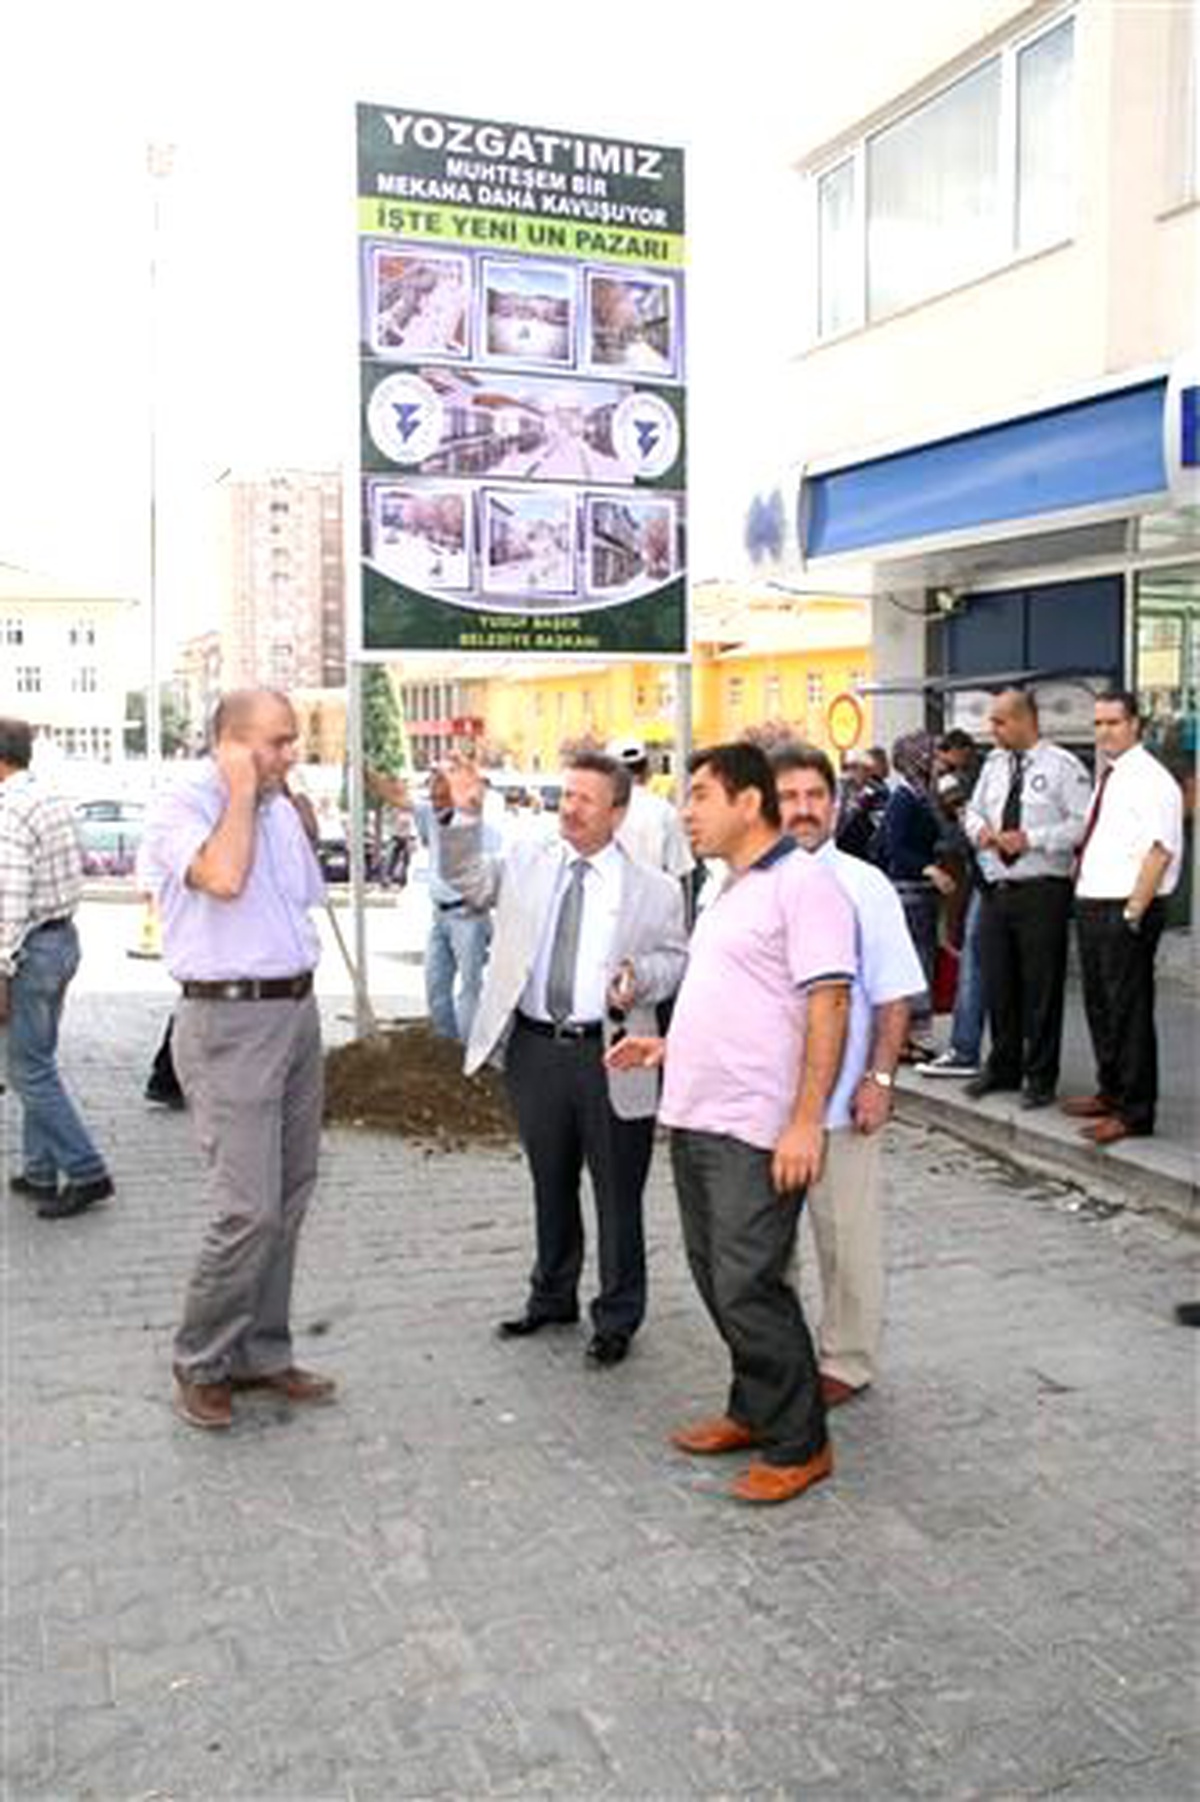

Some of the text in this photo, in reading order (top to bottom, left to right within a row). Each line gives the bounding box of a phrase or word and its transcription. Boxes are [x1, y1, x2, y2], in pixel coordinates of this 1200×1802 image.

[383, 114, 663, 180] YOZGAT'IMIZ
[376, 173, 668, 228] MEKANA DAHA KAVUŞUYOR
[572, 172, 608, 198] BİR
[377, 201, 669, 260] İŞTE YENİ UN PAZARI
